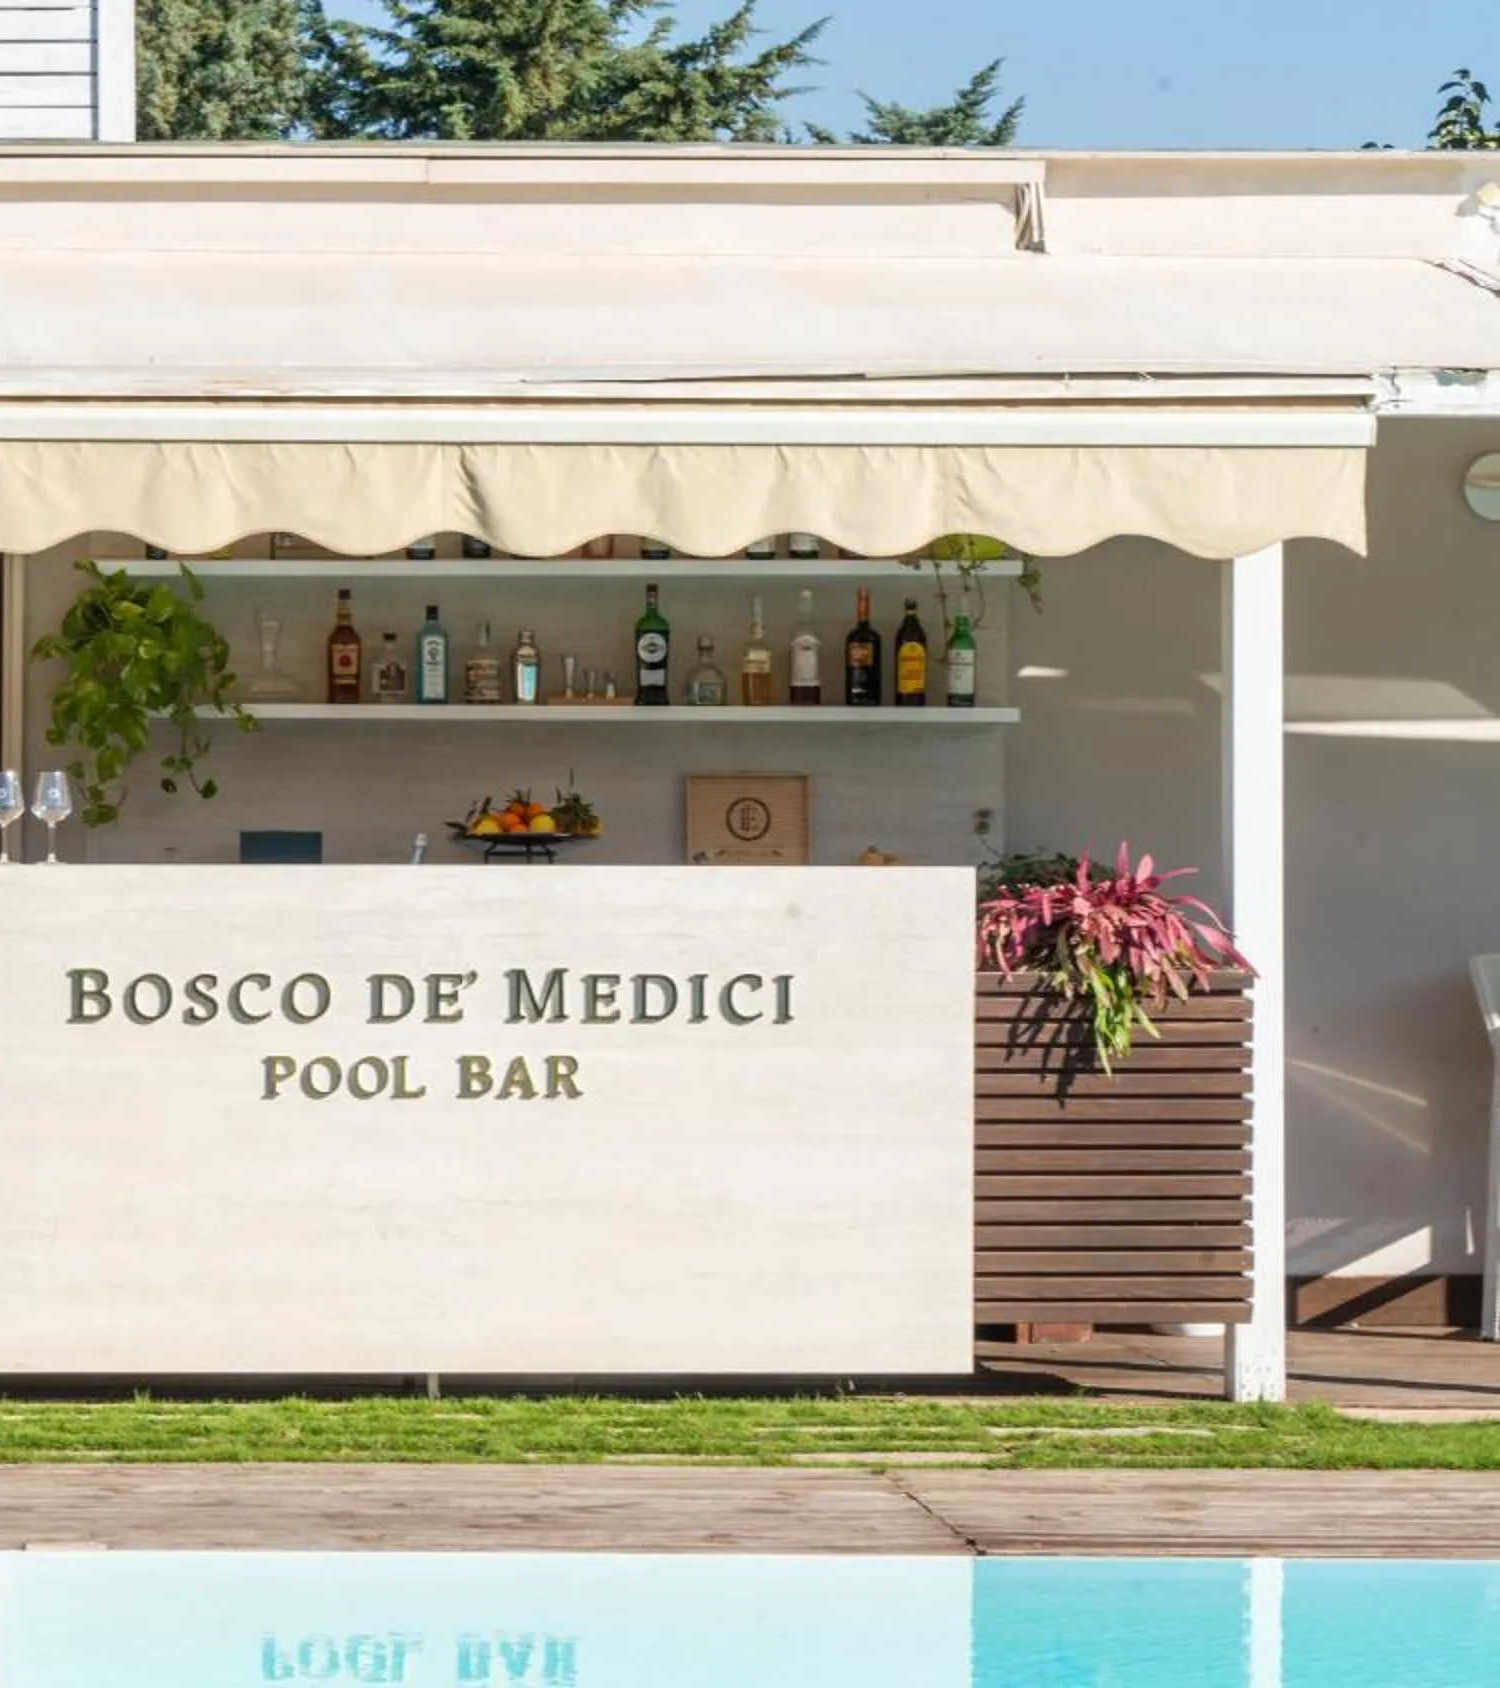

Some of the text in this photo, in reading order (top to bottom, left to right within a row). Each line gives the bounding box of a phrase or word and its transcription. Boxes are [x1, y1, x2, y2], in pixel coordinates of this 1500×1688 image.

[65, 967, 331, 1026] BOSCO
[503, 967, 795, 1026] MEDICI
[261, 1055, 584, 1101] POOL BAR
